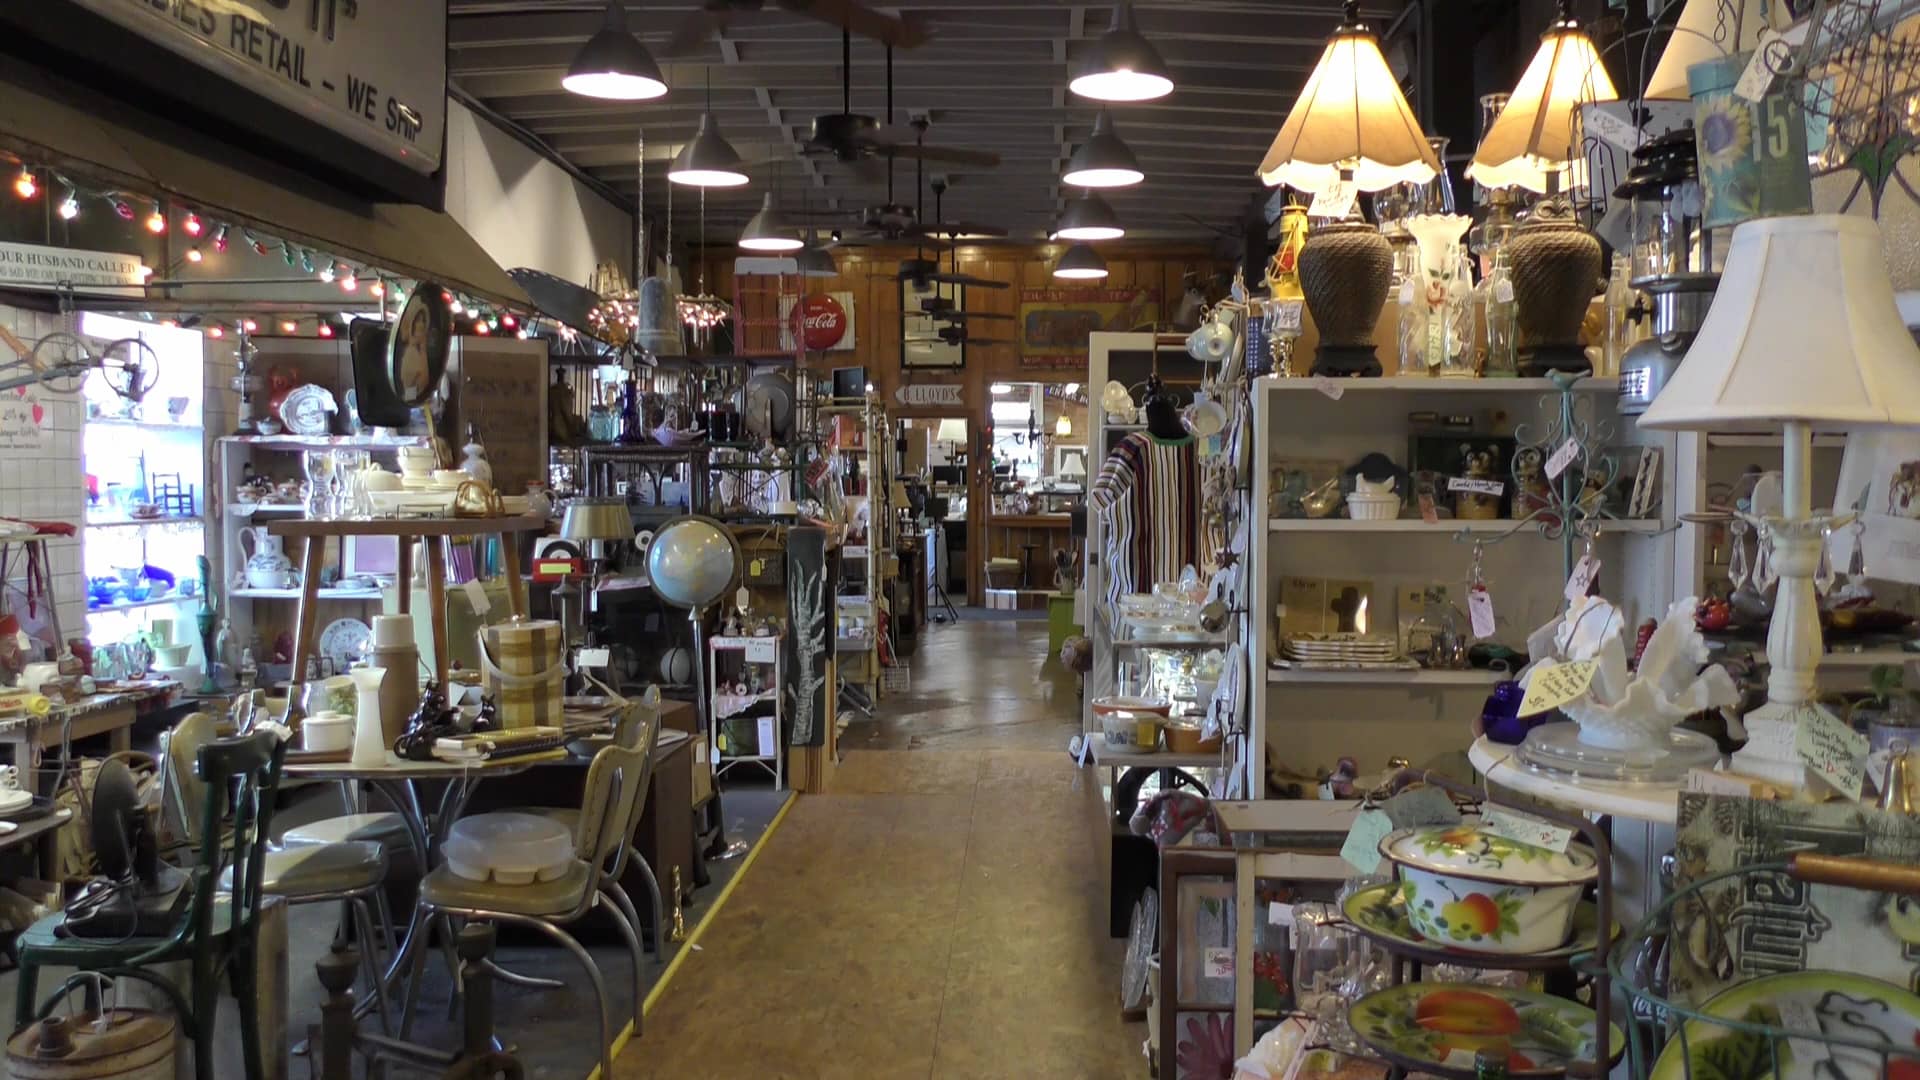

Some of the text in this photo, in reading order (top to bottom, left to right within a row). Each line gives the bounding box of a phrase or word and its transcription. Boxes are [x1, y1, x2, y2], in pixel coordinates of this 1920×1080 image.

[229, 13, 312, 89] RETAIL
[347, 73, 378, 122] WE
[385, 97, 423, 143] SHIP
[27, 252, 85, 269] HUSBAND
[87, 260, 136, 274] CALLED
